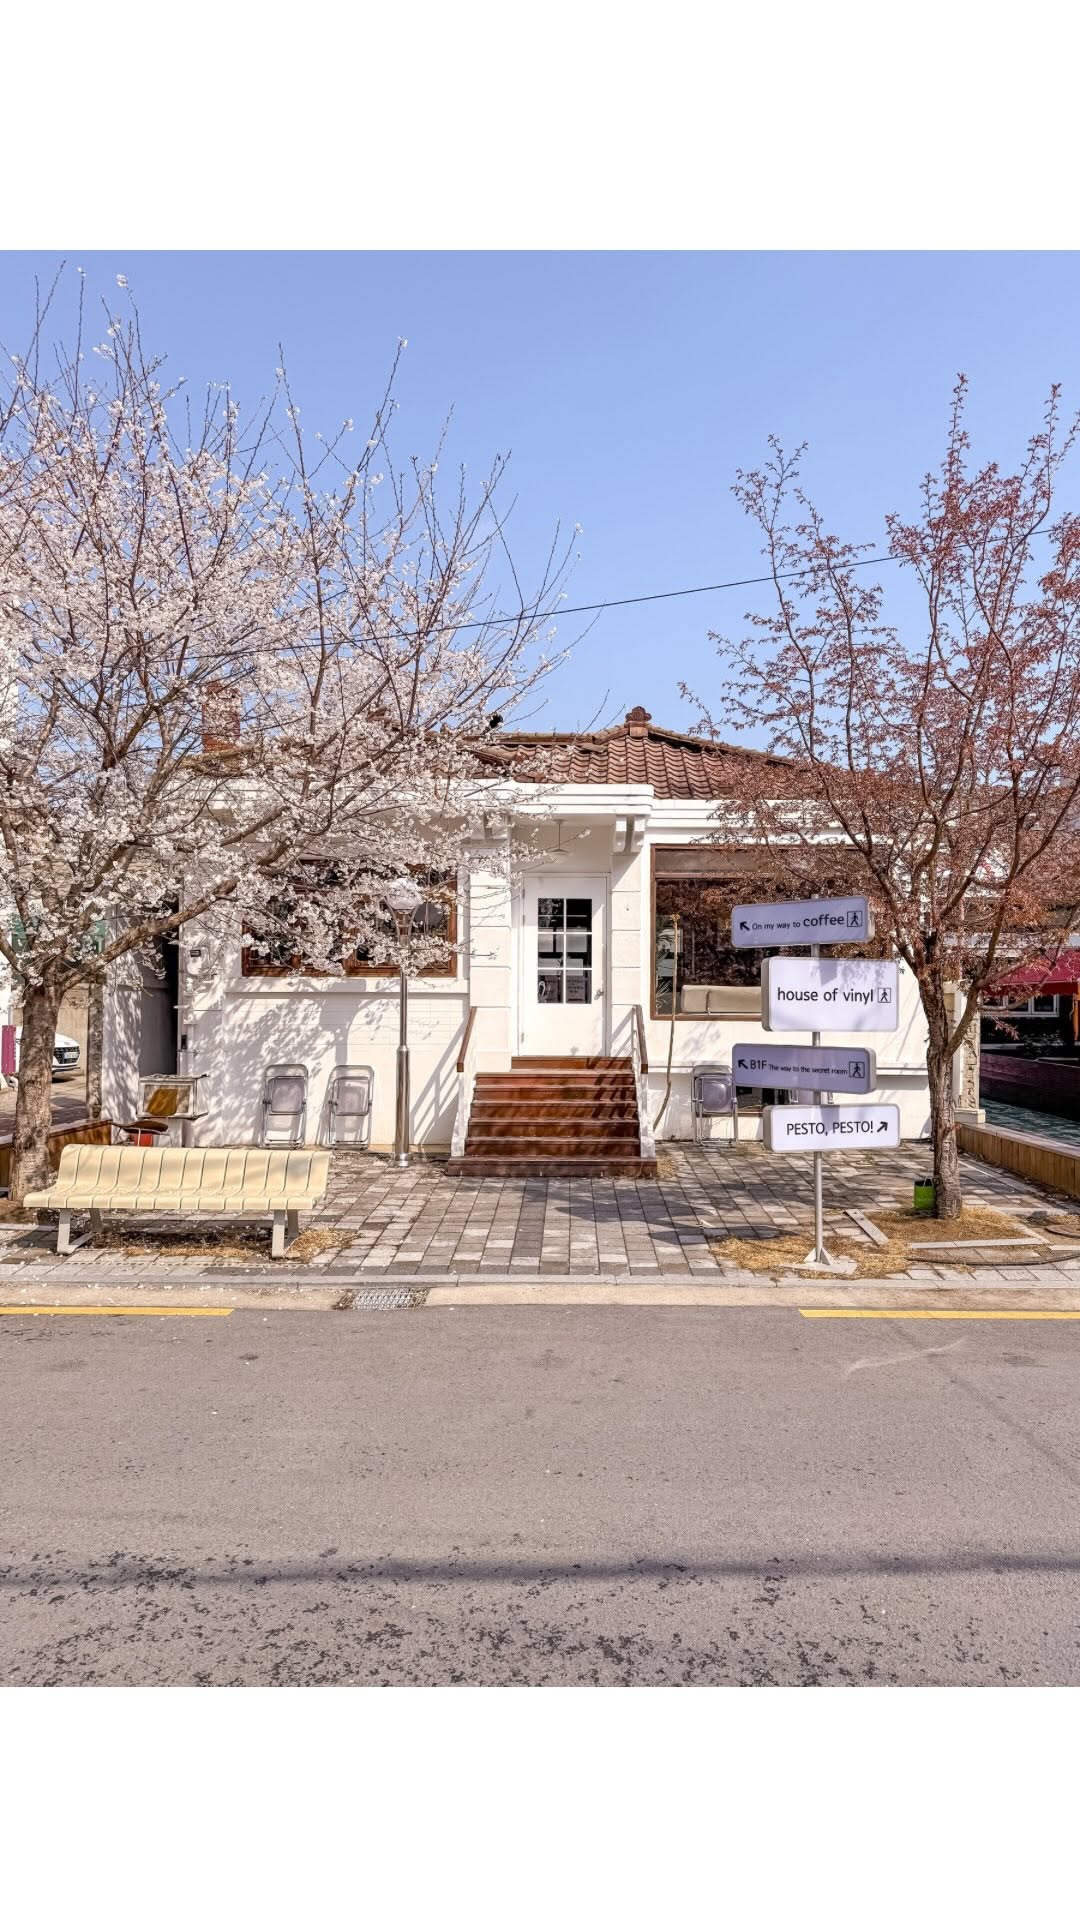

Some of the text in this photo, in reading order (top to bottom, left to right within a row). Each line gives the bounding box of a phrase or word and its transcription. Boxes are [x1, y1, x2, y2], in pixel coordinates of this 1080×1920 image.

[803, 914, 844, 927] coffee
[777, 987, 874, 1005] house of vinyl
[750, 1060, 767, 1070] B1F
[787, 1120, 873, 1136] PESTO, PESTO!
